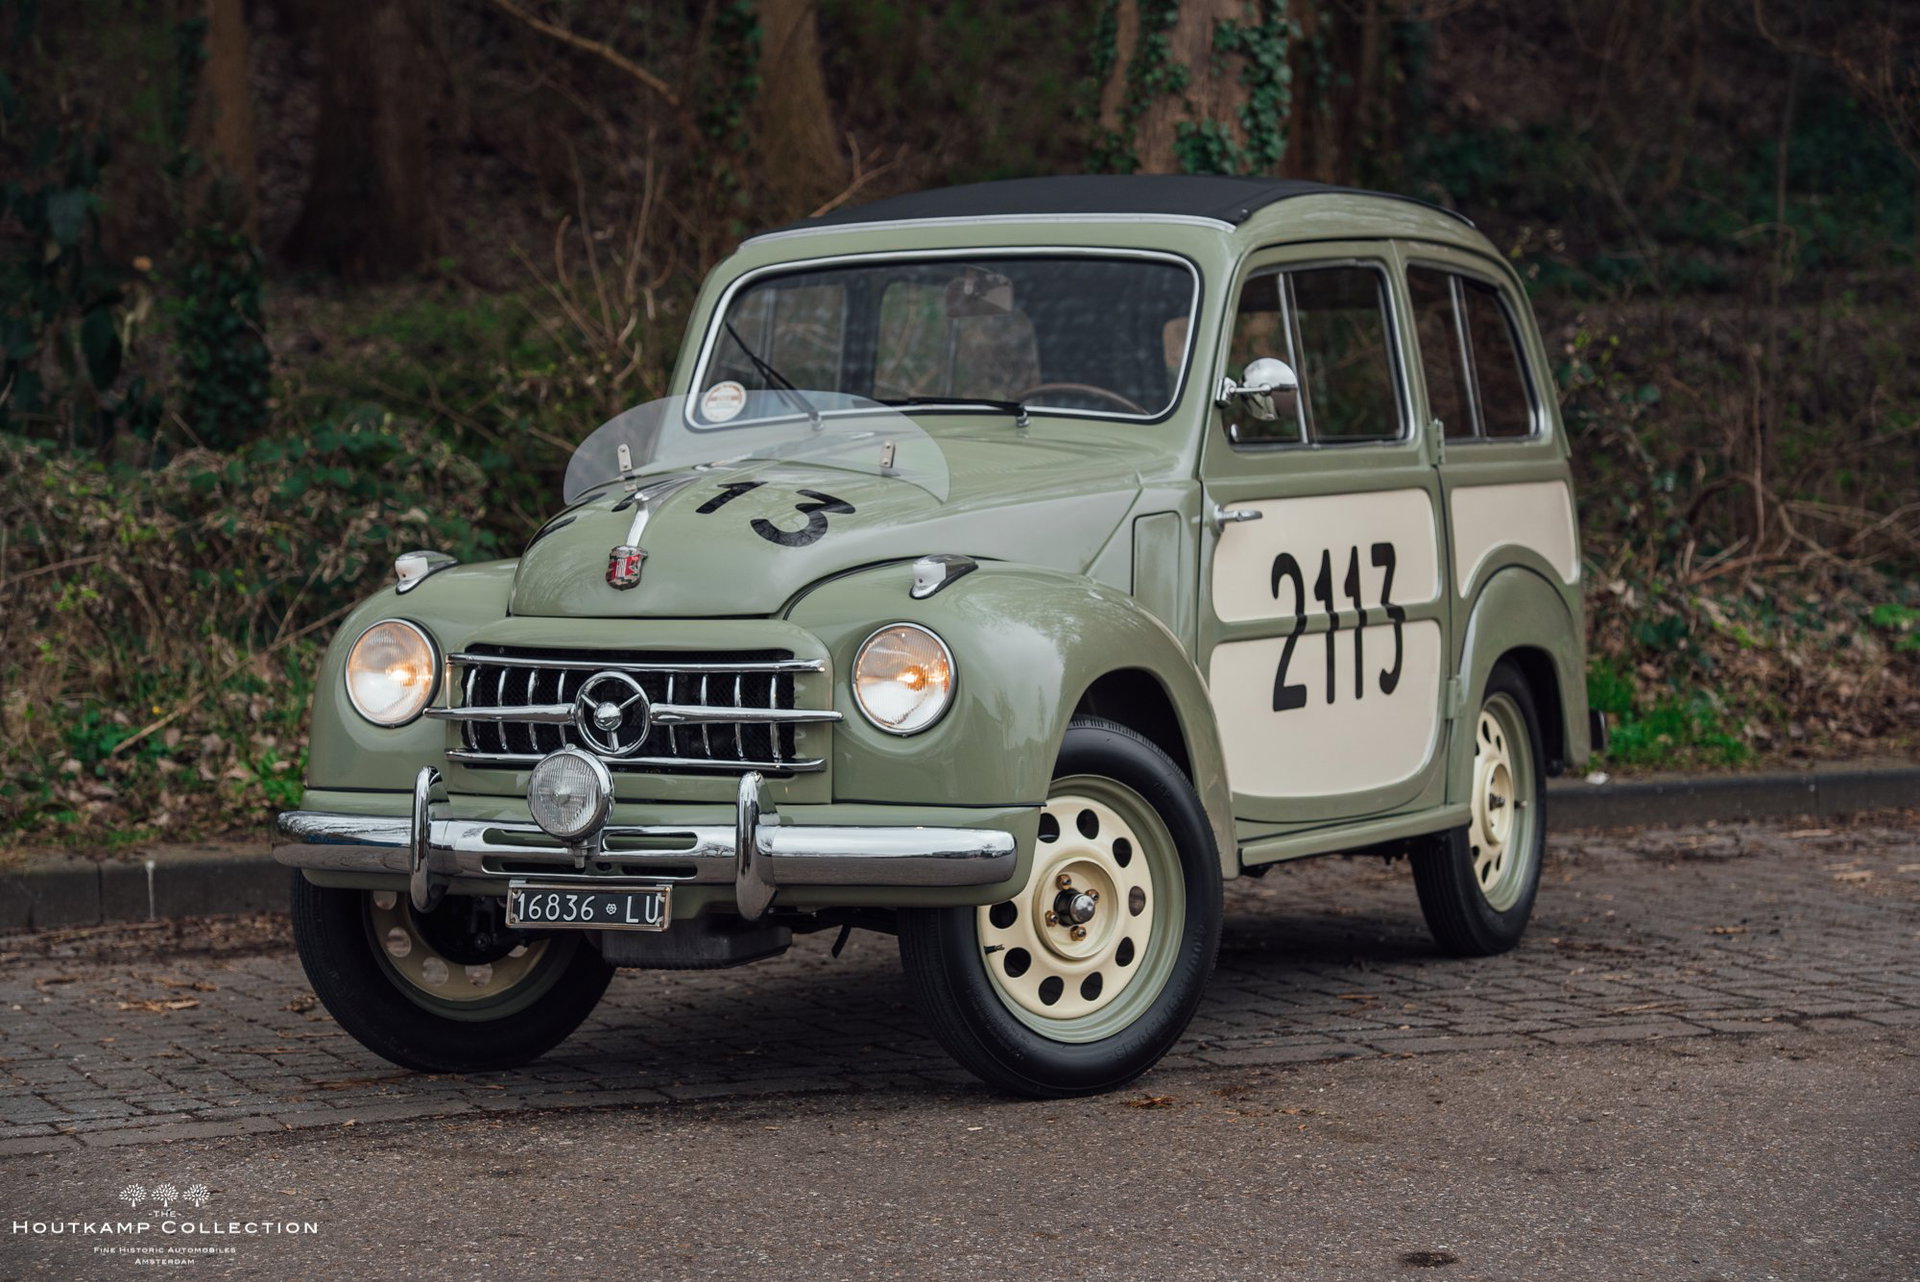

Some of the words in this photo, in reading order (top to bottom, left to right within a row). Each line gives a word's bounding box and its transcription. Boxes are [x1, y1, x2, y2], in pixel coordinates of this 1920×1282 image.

[1271, 542, 1406, 712] 2113
[517, 892, 596, 921] 16836
[625, 895, 660, 924] LU
